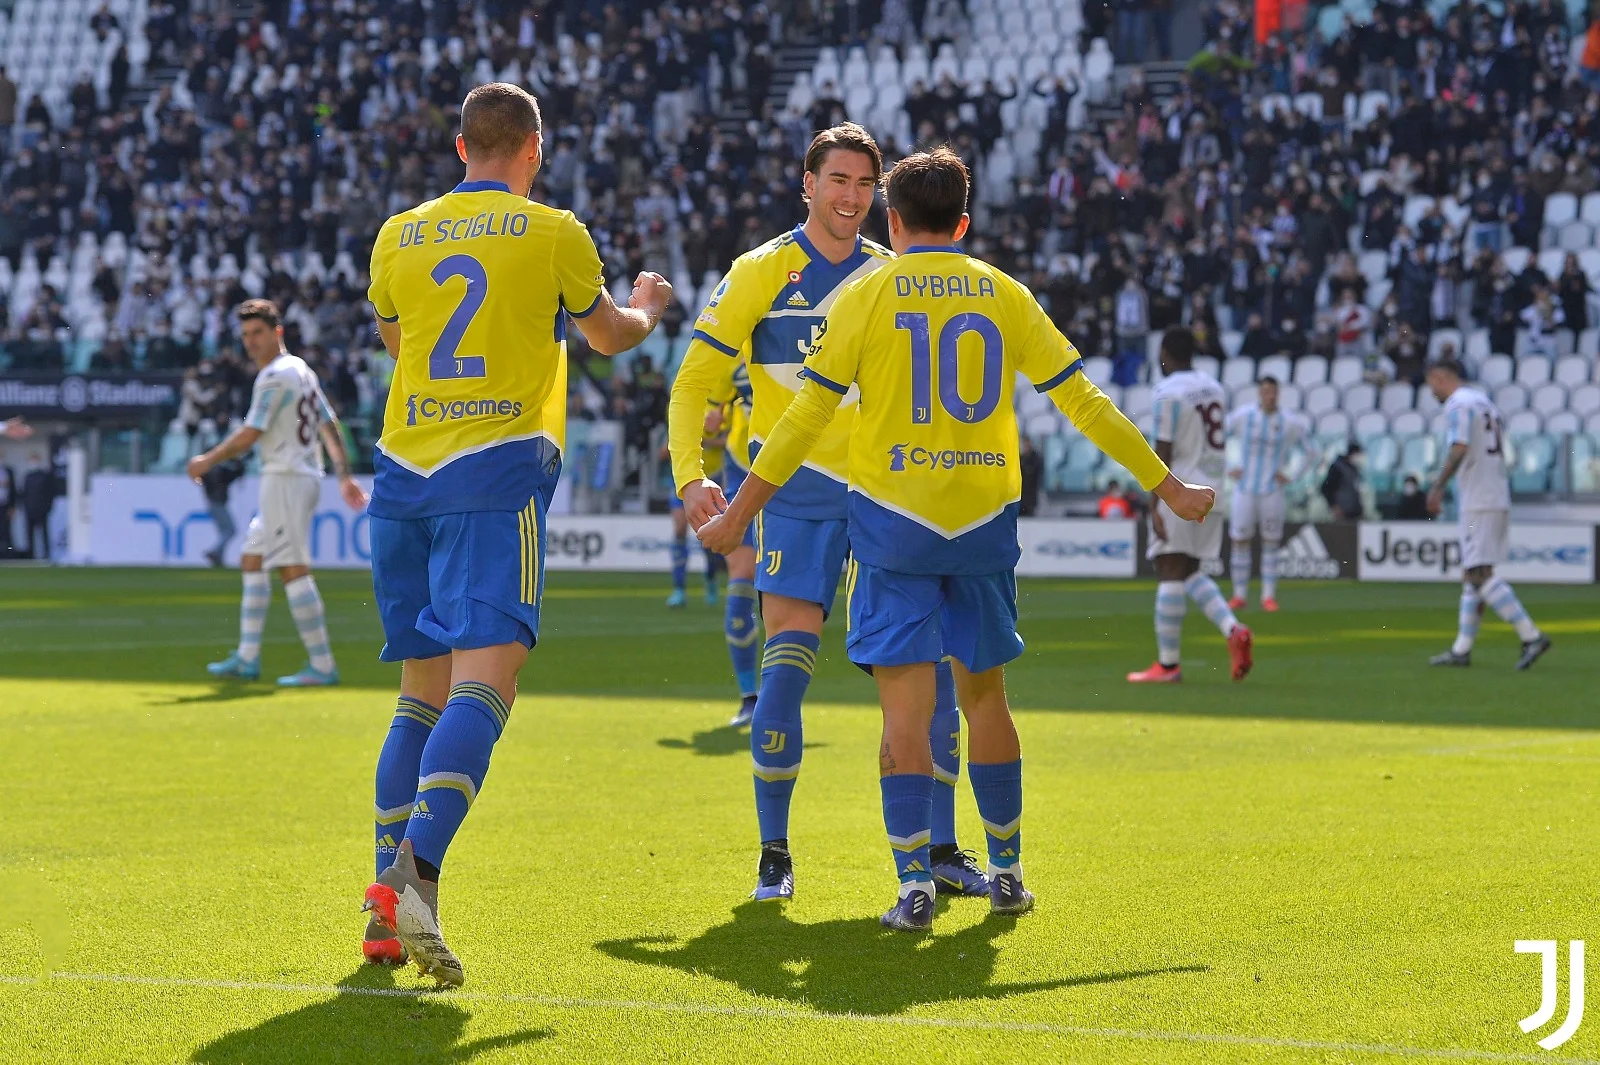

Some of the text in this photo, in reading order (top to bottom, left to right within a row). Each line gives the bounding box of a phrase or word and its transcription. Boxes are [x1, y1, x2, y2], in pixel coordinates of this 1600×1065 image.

[399, 212, 529, 248] DE SCIGLIO
[895, 275, 995, 297] DYBALA
[429, 253, 488, 381] 2
[894, 311, 1004, 425] 10
[420, 396, 523, 422] Cygames
[1195, 401, 1225, 450] 18
[910, 446, 1006, 470] Cygames
[1364, 529, 1462, 572] Jeep
